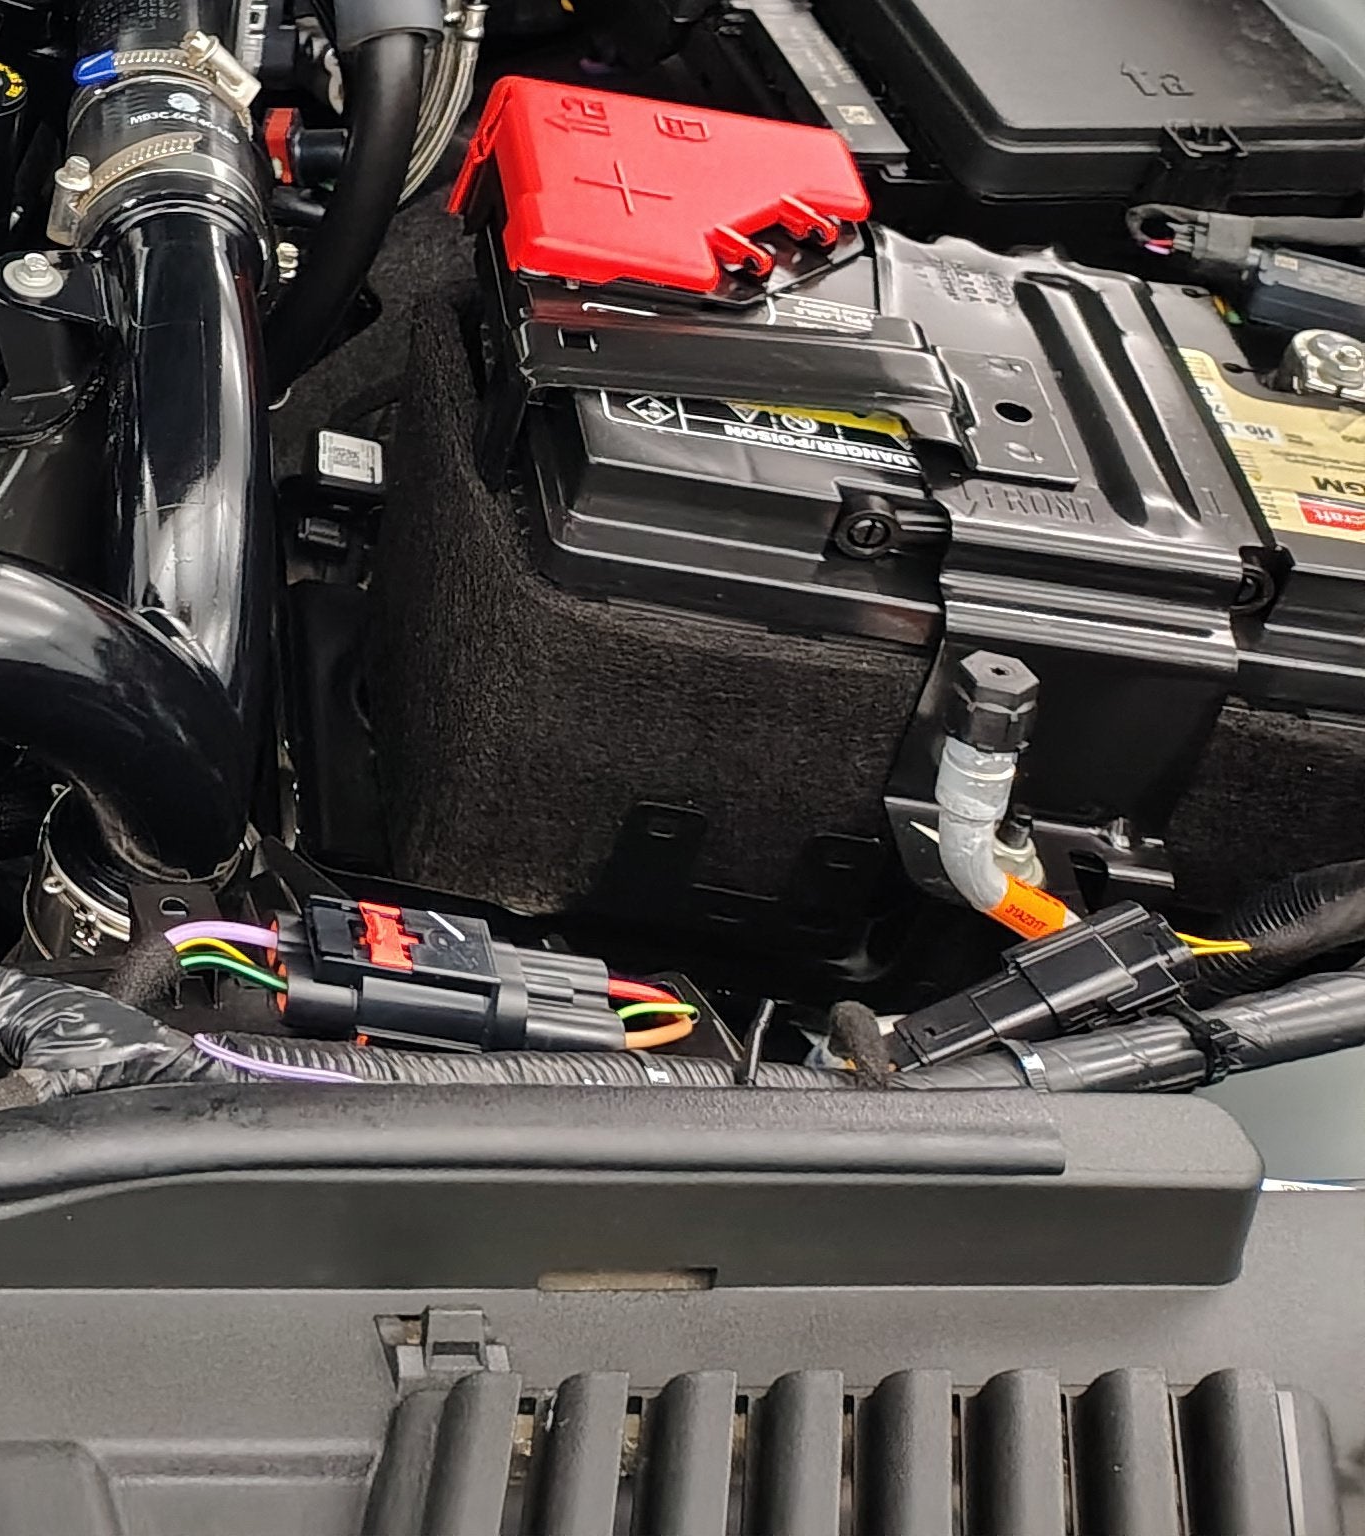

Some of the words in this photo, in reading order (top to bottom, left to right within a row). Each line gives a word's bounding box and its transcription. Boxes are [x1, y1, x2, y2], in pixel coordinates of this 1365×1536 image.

[722, 424, 910, 467] DANGER/POISON
[982, 483, 1096, 524] FRONT
[1311, 508, 1365, 528] craft
